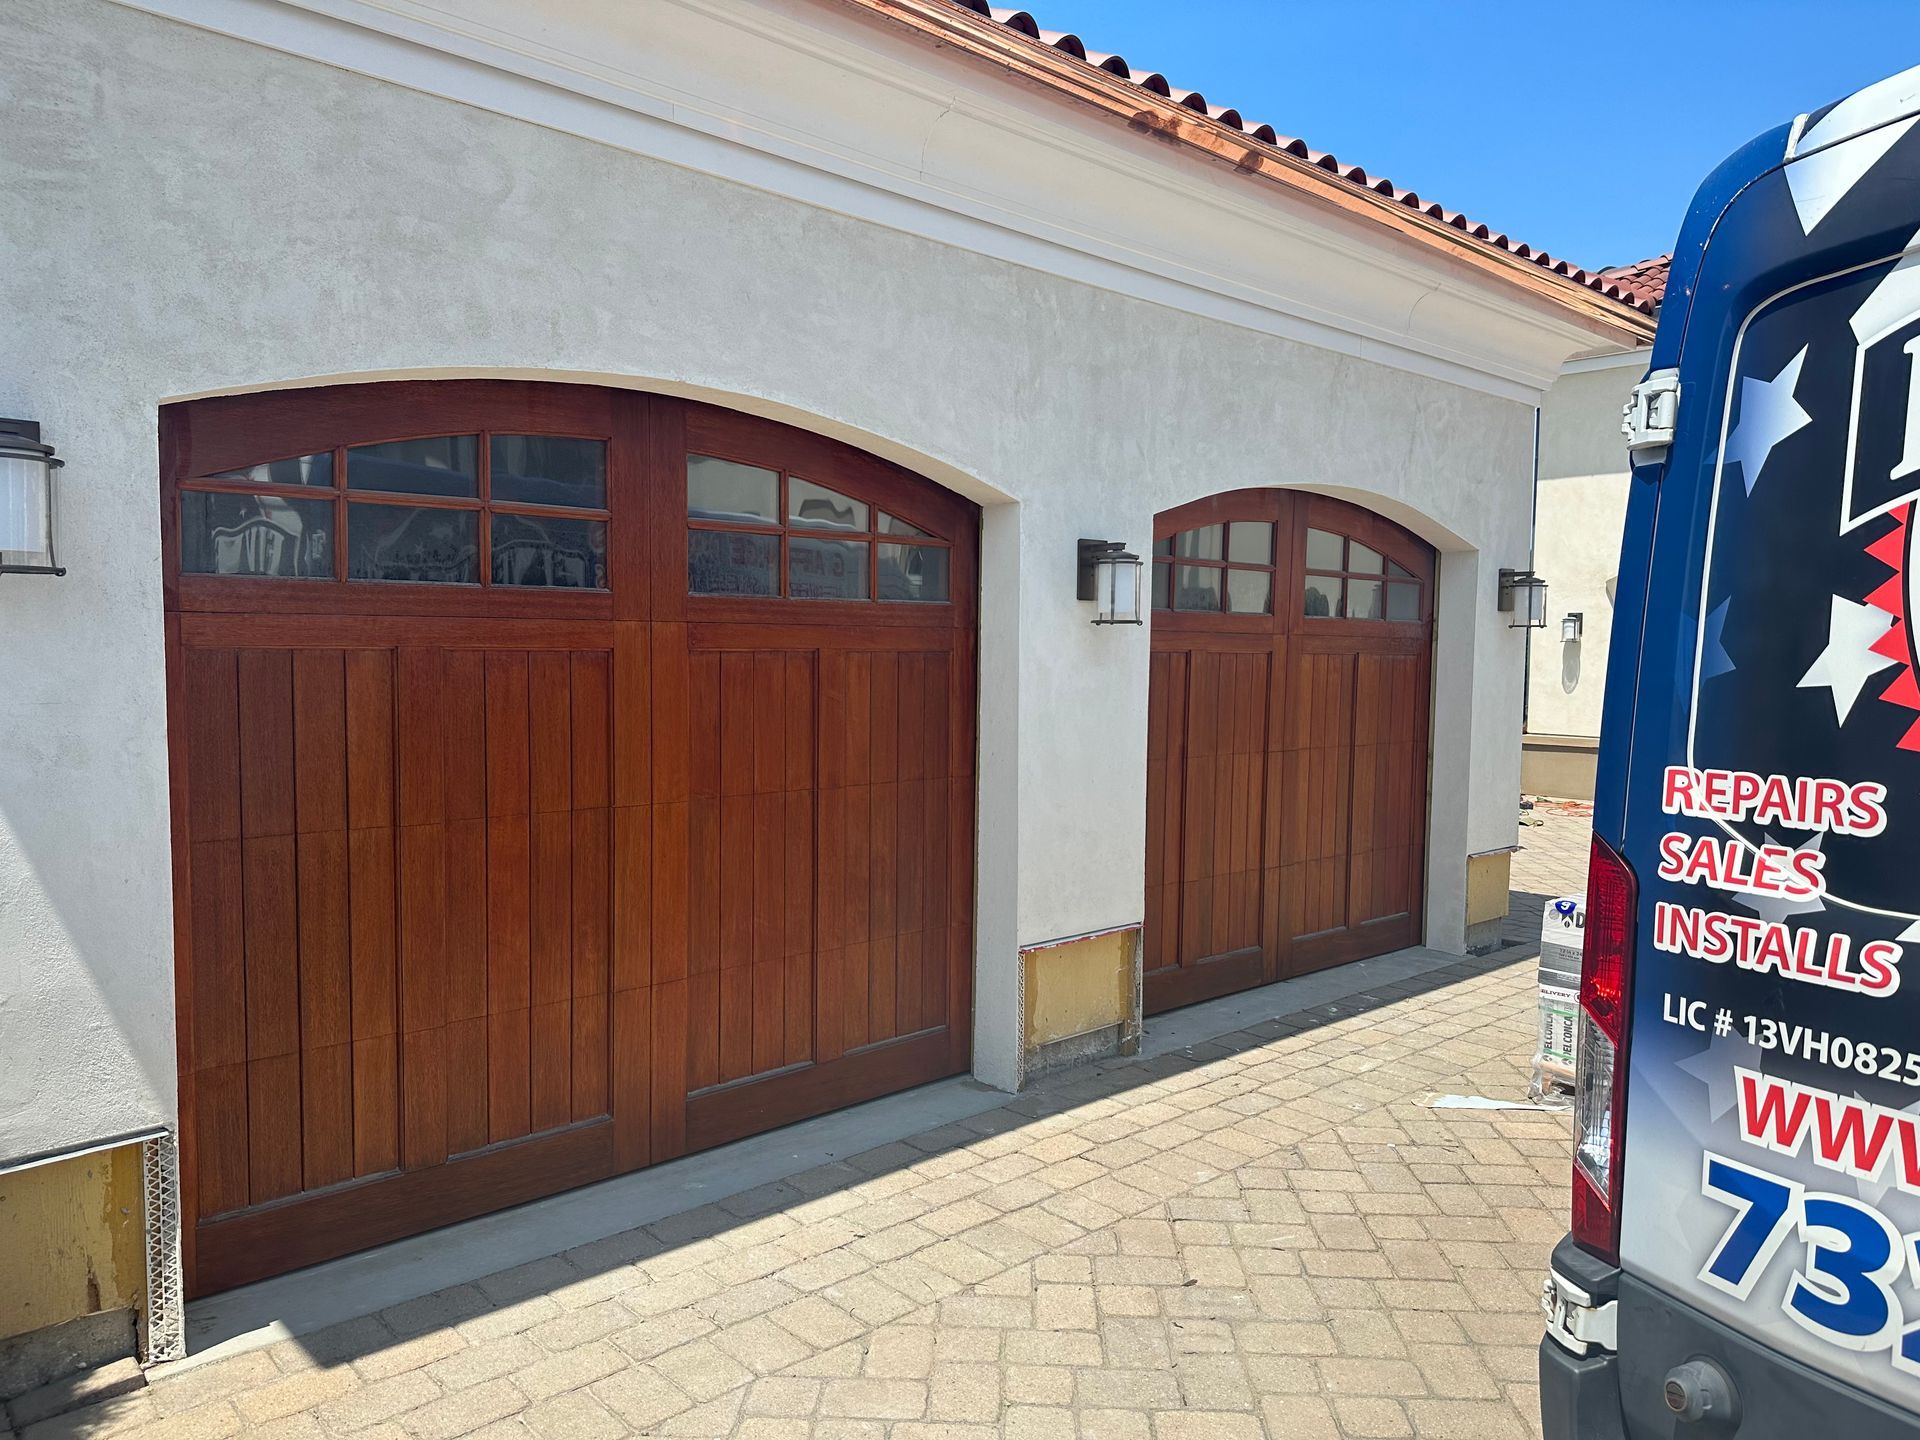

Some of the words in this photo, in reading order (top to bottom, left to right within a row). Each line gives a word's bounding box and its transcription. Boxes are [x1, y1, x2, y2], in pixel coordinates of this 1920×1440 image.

[1663, 766, 1887, 836] REPAIRS
[1658, 833, 1825, 901] SALES
[1654, 902, 1903, 997] INSTALLS
[1663, 993, 1707, 1031] LIC
[1714, 1008, 1733, 1037] #
[1743, 1016, 1920, 1087] 13VH0825
[1735, 1066, 1920, 1195] WW
[1698, 1150, 1920, 1376] 73
